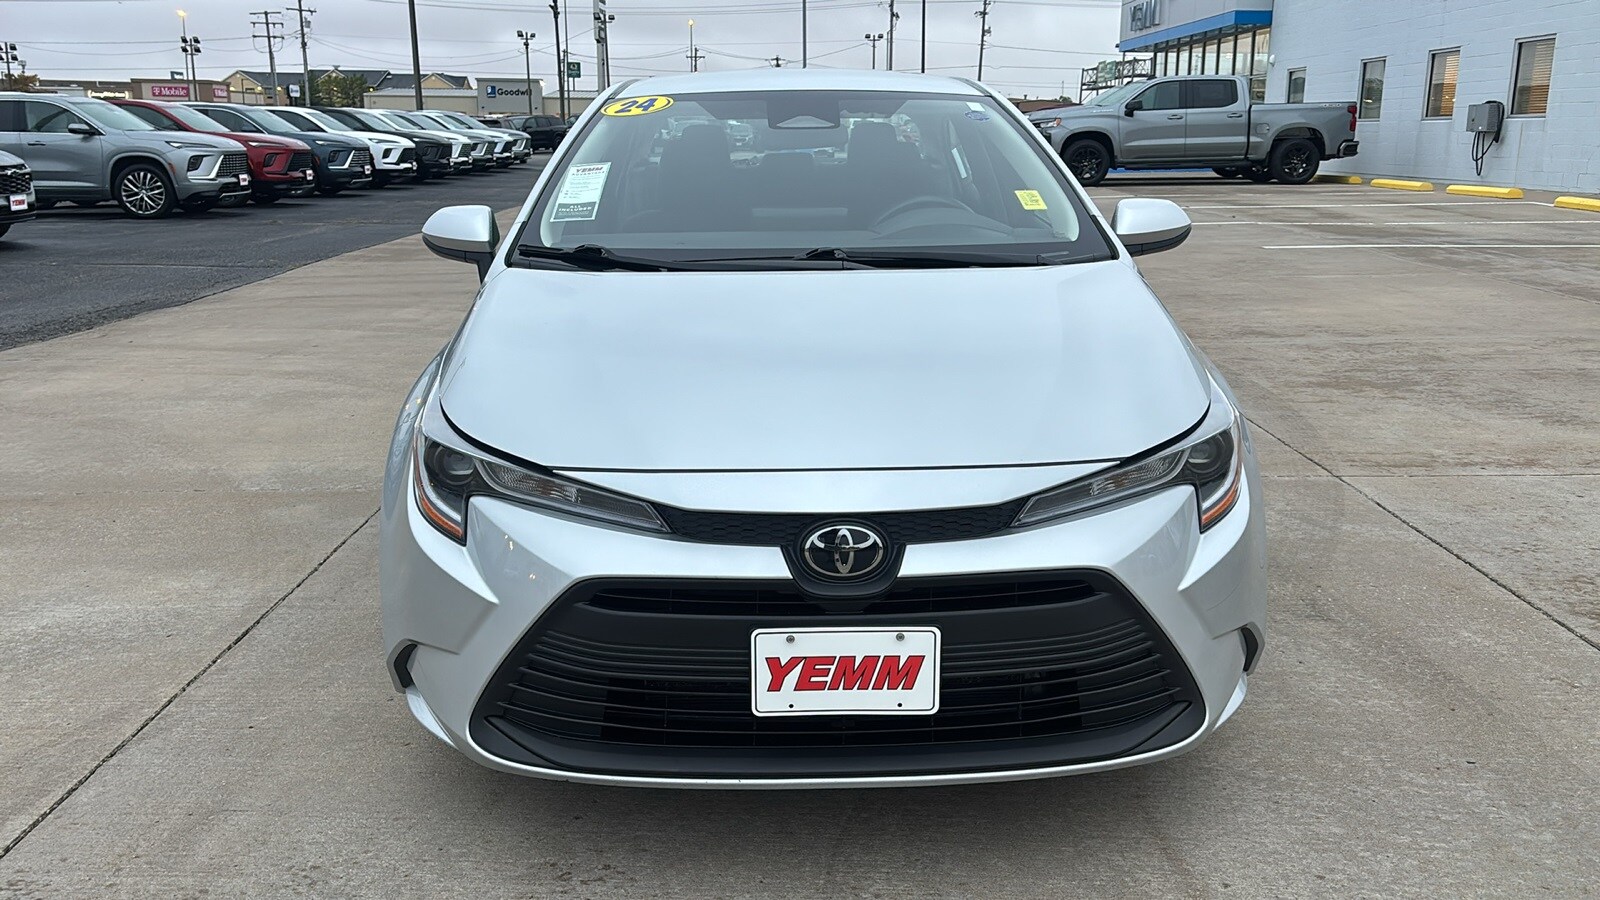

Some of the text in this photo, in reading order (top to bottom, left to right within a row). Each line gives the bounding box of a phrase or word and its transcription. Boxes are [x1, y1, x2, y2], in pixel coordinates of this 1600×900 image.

[161, 87, 187, 96] Mobile
[614, 98, 658, 114] 24
[765, 655, 926, 692] YEMM
